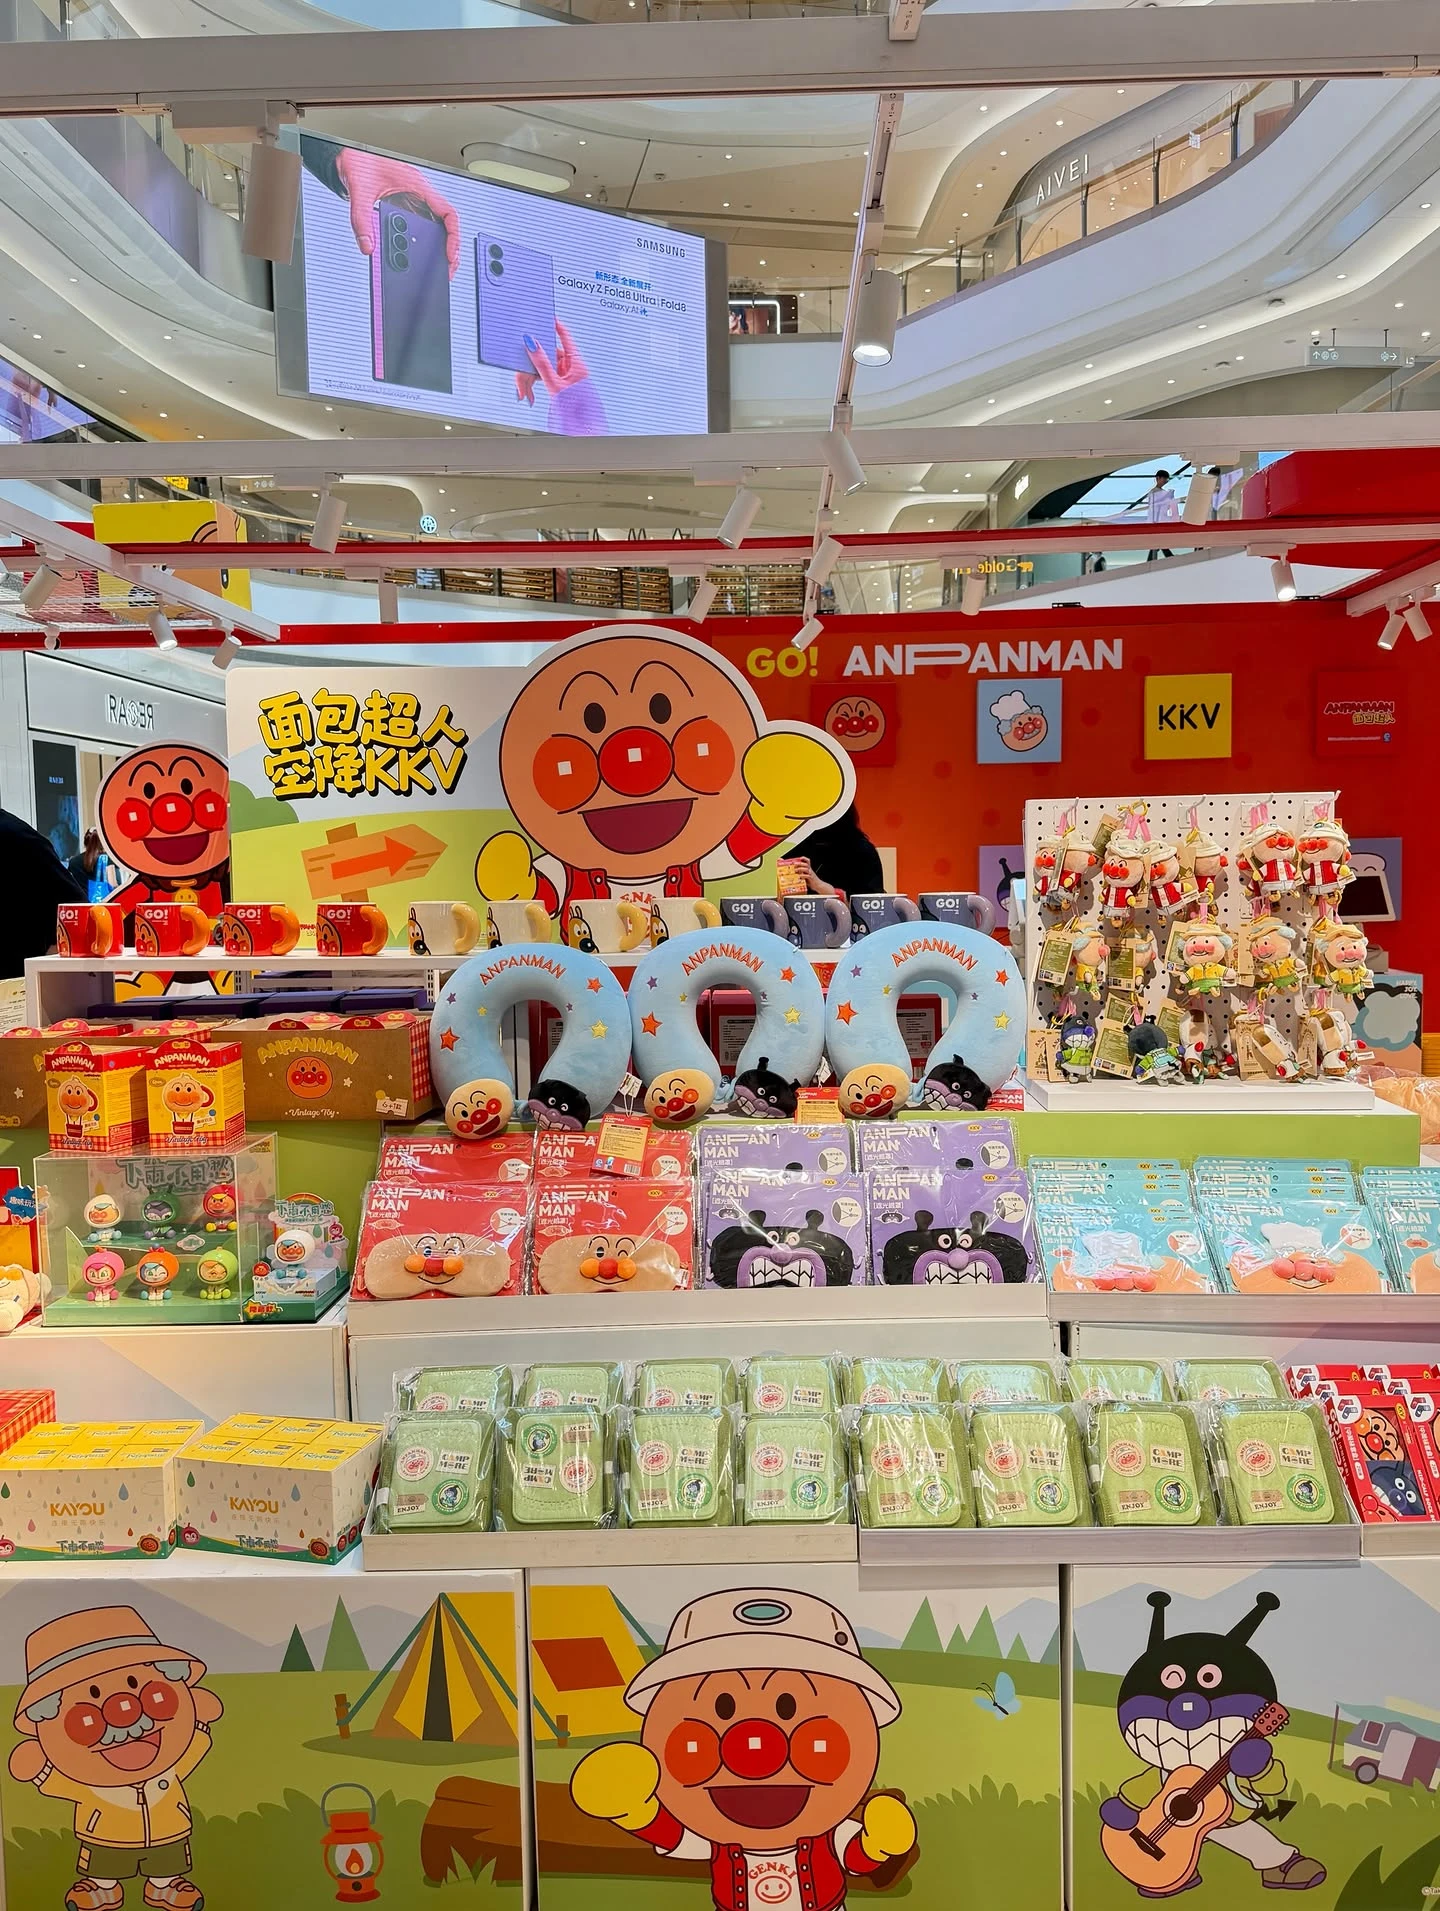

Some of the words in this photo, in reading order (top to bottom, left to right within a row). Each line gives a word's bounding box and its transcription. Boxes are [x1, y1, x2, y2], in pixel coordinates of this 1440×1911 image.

[1036, 154, 1088, 205] AIVEI
[636, 237, 686, 258] SAMSUNG
[557, 275, 595, 294] Galaxy
[596, 283, 603, 294] Z
[604, 286, 631, 300] Fold8
[633, 291, 657, 306] Ultra
[661, 298, 687, 312] Fold8
[600, 298, 630, 313] Galaxy
[746, 647, 819, 678] GO!
[842, 638, 1123, 677] ANPANMAN
[258, 688, 469, 750] 面包超人
[1157, 702, 1221, 732] KKV
[264, 744, 468, 800] 空降KKV
[731, 903, 755, 913] GO!
[793, 902, 816, 912] GO!
[861, 899, 885, 910] GO!
[935, 898, 960, 909] GO!
[59, 908, 79, 921] GO!
[144, 908, 169, 920] GO!
[236, 908, 261, 920] GO!
[326, 908, 351, 920] GO!
[681, 942, 765, 977] ANPANMAN
[890, 938, 979, 972] ANPANMAN
[479, 954, 567, 986] ANPANMAN
[257, 1036, 360, 1065] ANPANMAN
[51, 1055, 95, 1071] ANPANMAN
[154, 1053, 211, 1068] ANPANMAN
[289, 1109, 321, 1119] Vintage
[321, 1109, 335, 1118] Toy
[704, 1133, 770, 1146] ANPAN
[863, 1126, 931, 1140] ANPAN
[541, 1133, 598, 1147] ANPA
[863, 1140, 900, 1153] MAN
[386, 1143, 454, 1156] ANPAN
[539, 1147, 575, 1158] MAN
[704, 1146, 739, 1159] MAN
[384, 1156, 421, 1168] MAN
[873, 1172, 944, 1187] ANPAN
[374, 1188, 445, 1200] ANPAN
[540, 1190, 609, 1203] ANPAN
[712, 1184, 749, 1198] MAN
[872, 1187, 910, 1201] MAN
[371, 1200, 410, 1212] MAN
[538, 1204, 576, 1217] MAN
[1213, 1215, 1253, 1226] MAN
[1043, 1226, 1080, 1237] MAN
[1397, 1405, 1405, 1418] KKV
[1152, 1448, 1182, 1459] CAMP
[1281, 1447, 1312, 1457] CAMP
[1152, 1456, 1183, 1467] MORE
[1281, 1455, 1313, 1466] MORE
[50, 1502, 105, 1517] KAYOU
[229, 1496, 279, 1514] KAYOU
[397, 1505, 420, 1513] ENJOY
[1121, 1502, 1145, 1510] ENJOY
[1254, 1501, 1278, 1510] ENJOY
[748, 1861, 797, 1880] GENKI
